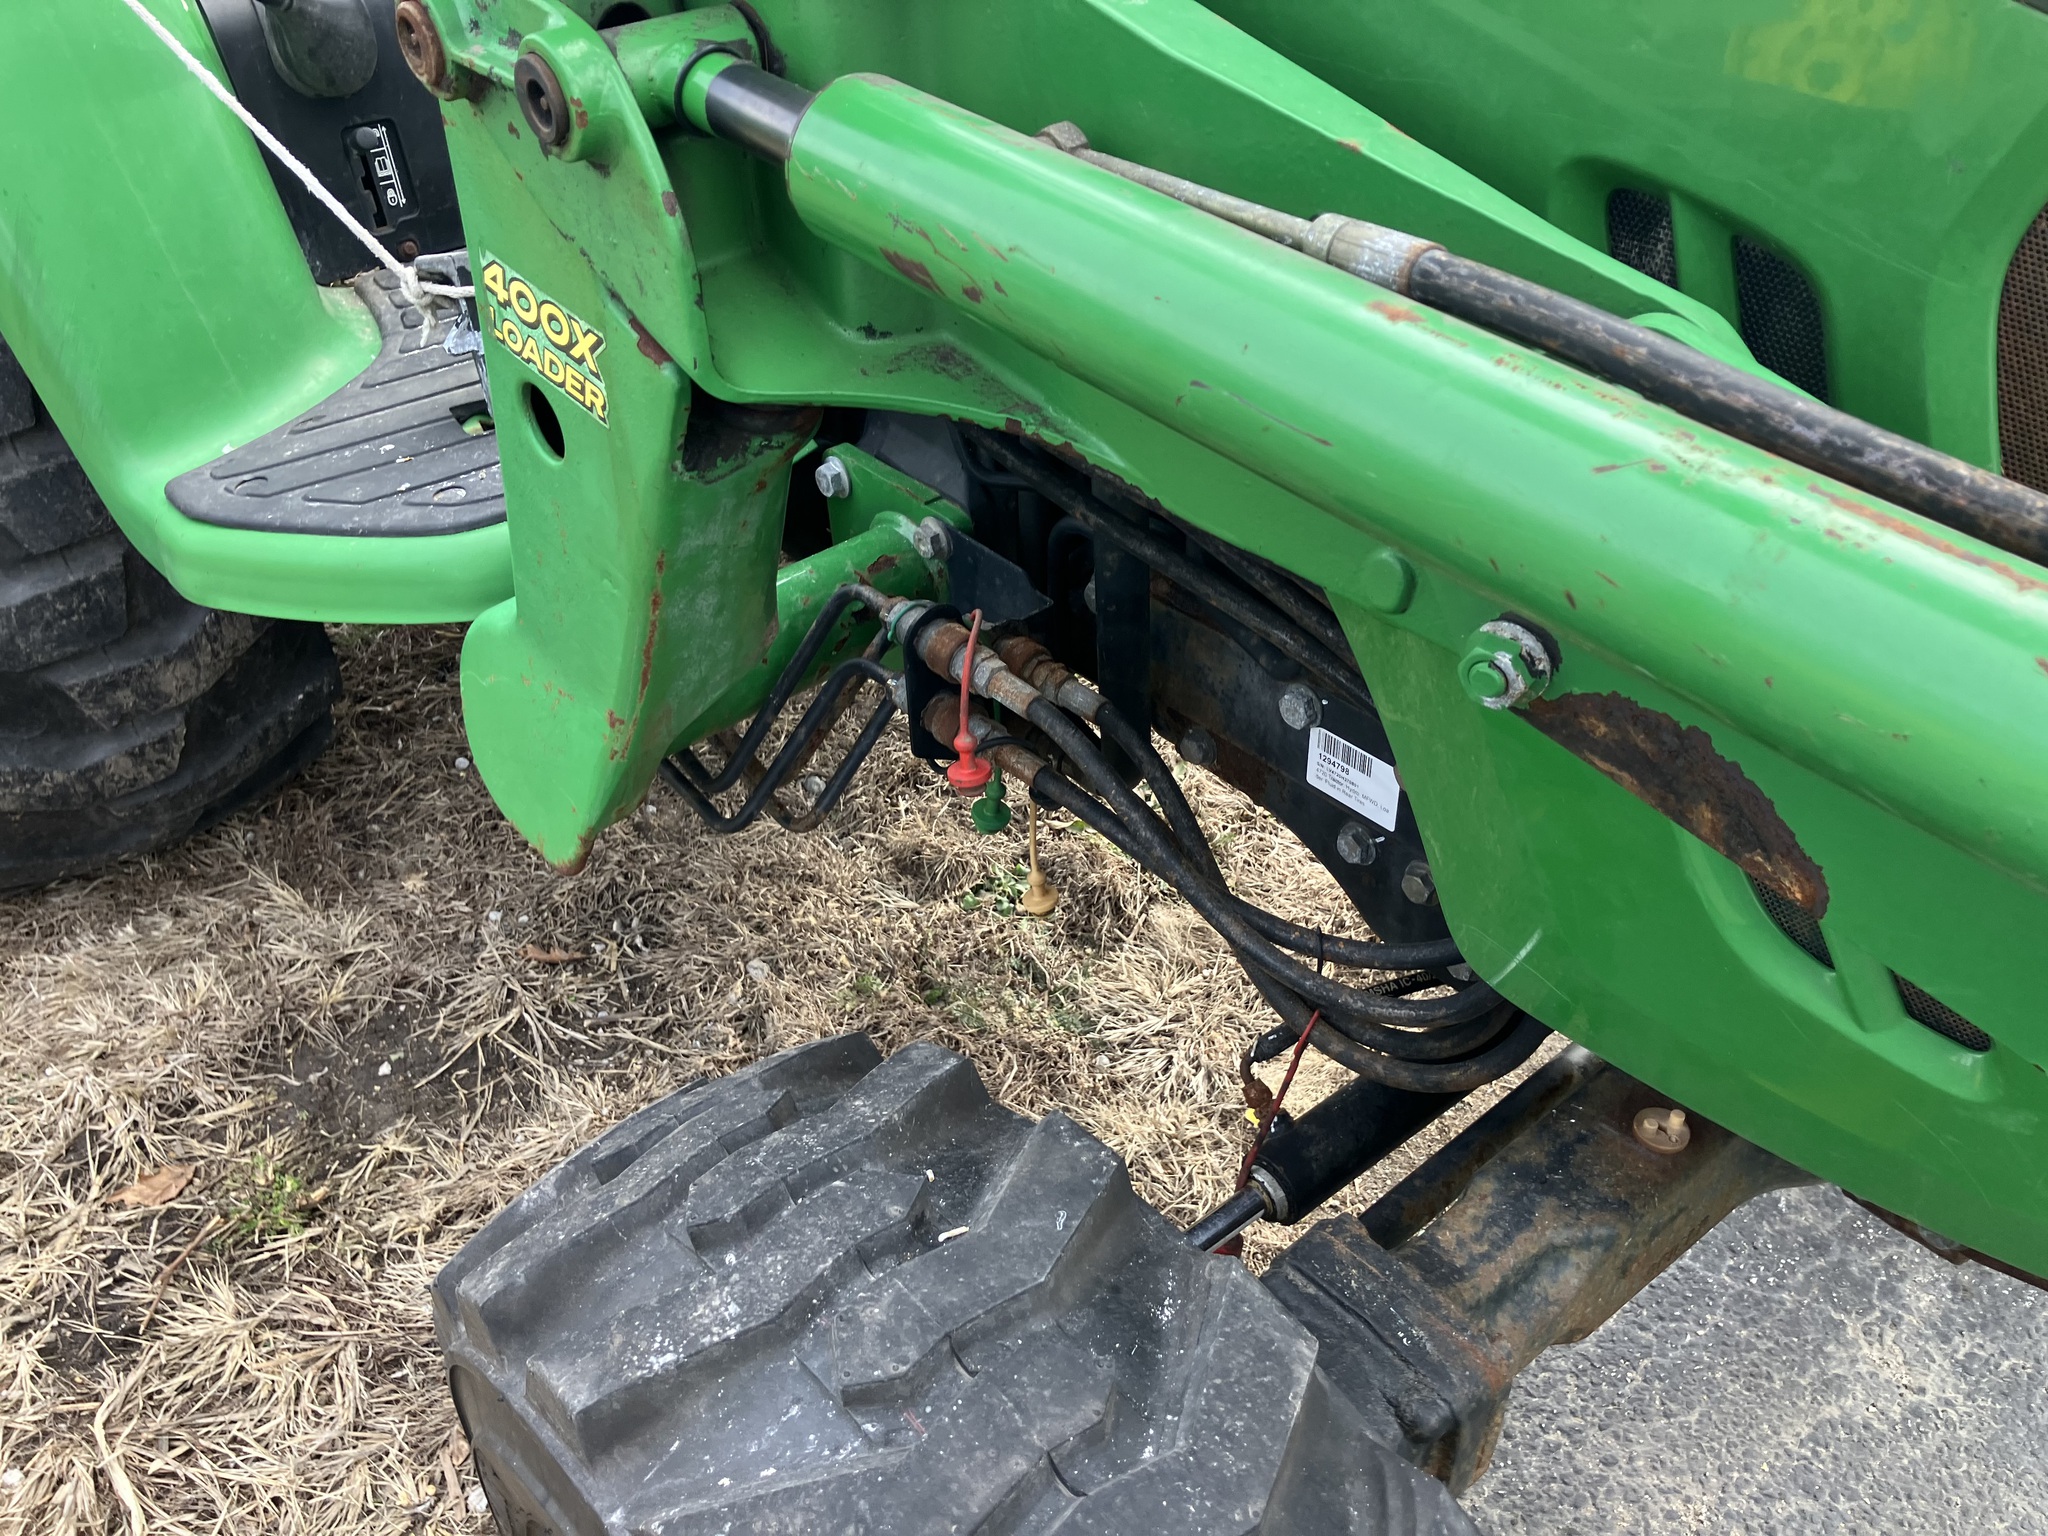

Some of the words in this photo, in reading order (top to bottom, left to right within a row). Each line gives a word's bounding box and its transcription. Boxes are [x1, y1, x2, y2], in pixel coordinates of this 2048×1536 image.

[483, 260, 603, 380] 400X
[489, 306, 607, 422] LOADER
[1318, 753, 1350, 776] 1294798
